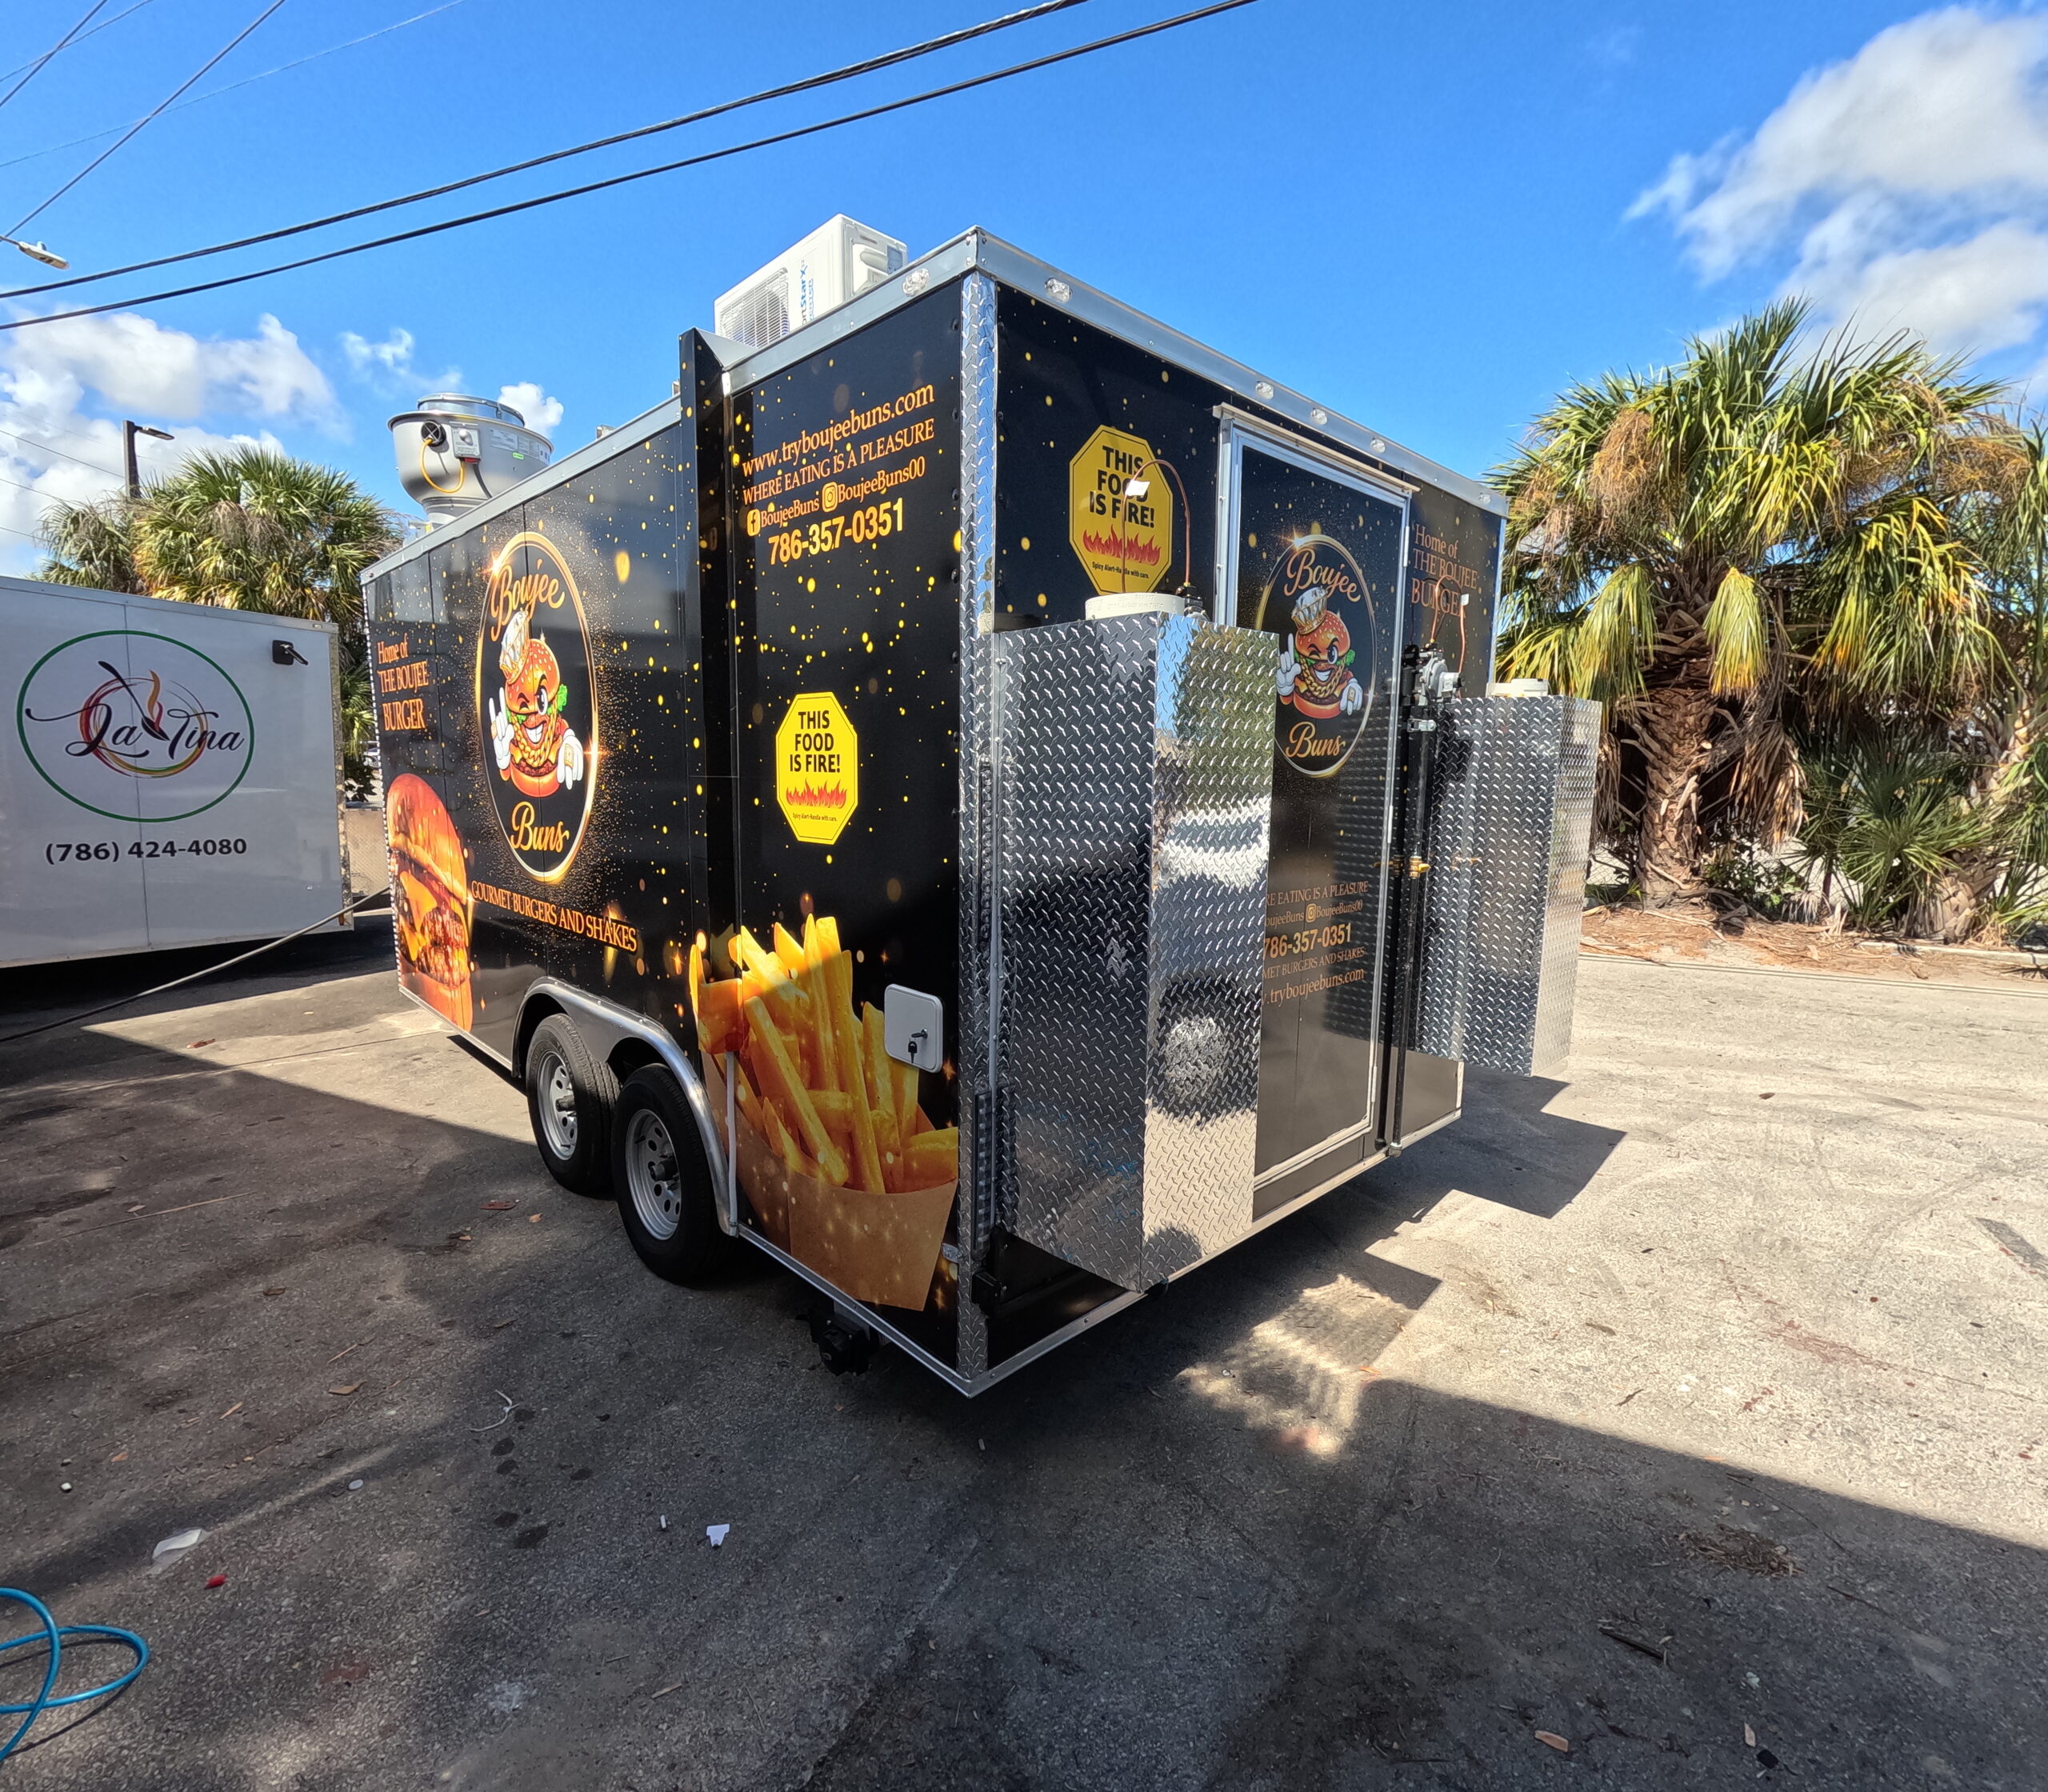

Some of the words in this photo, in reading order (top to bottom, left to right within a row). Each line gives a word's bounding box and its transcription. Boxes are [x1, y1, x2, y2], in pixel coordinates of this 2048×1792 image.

[742, 383, 934, 477] www.tryboujeebuns.com
[743, 476, 782, 505] WHERE
[785, 458, 830, 491] EATING
[833, 454, 844, 474] IS
[847, 450, 858, 469] A
[860, 418, 934, 464] PLEASURE
[838, 456, 926, 502] BoujeeBuns00
[1102, 446, 1144, 478] THIS
[1090, 491, 1106, 516] IS
[768, 498, 903, 566] 786-357-0351
[1414, 523, 1446, 554] Home
[1447, 540, 1459, 559] of
[1104, 563, 1130, 575] Alert-Hadle
[1283, 547, 1361, 602] Boujee
[1413, 548, 1437, 575] THE
[1439, 559, 1478, 590] BOUJEE
[490, 558, 566, 642] Boujee
[378, 641, 399, 664] Home
[400, 633, 408, 658] of
[377, 669, 397, 694] THE
[396, 660, 429, 694] BOUJEE
[25, 703, 150, 758] La
[166, 708, 245, 760] Tina
[382, 698, 426, 731] BURGER
[798, 710, 830, 730] THIS
[794, 732, 834, 752] FOOD
[1285, 721, 1346, 758] Buns
[790, 754, 802, 772] IS
[806, 754, 840, 774] FIRE!
[510, 801, 569, 853] Buns
[45, 841, 119, 865] (786)
[127, 838, 247, 859] 424-4080
[1278, 888, 1312, 905] EATING
[1313, 887, 1321, 900] IS
[1322, 887, 1329, 898] A
[1330, 881, 1369, 898] PLEASURE
[471, 881, 512, 910] GOURMET
[513, 893, 558, 926] BURGERS
[558, 908, 585, 934] AND
[586, 914, 638, 952] SHAKES
[1265, 910, 1305, 929] oujeeBuns
[1263, 922, 1351, 959] 786-357-0351
[1282, 957, 1318, 976] BURGERS
[1319, 952, 1337, 967] AND
[1337, 946, 1365, 962] SHAKES
[1262, 968, 1364, 1007] .tryboujeebuns.com
